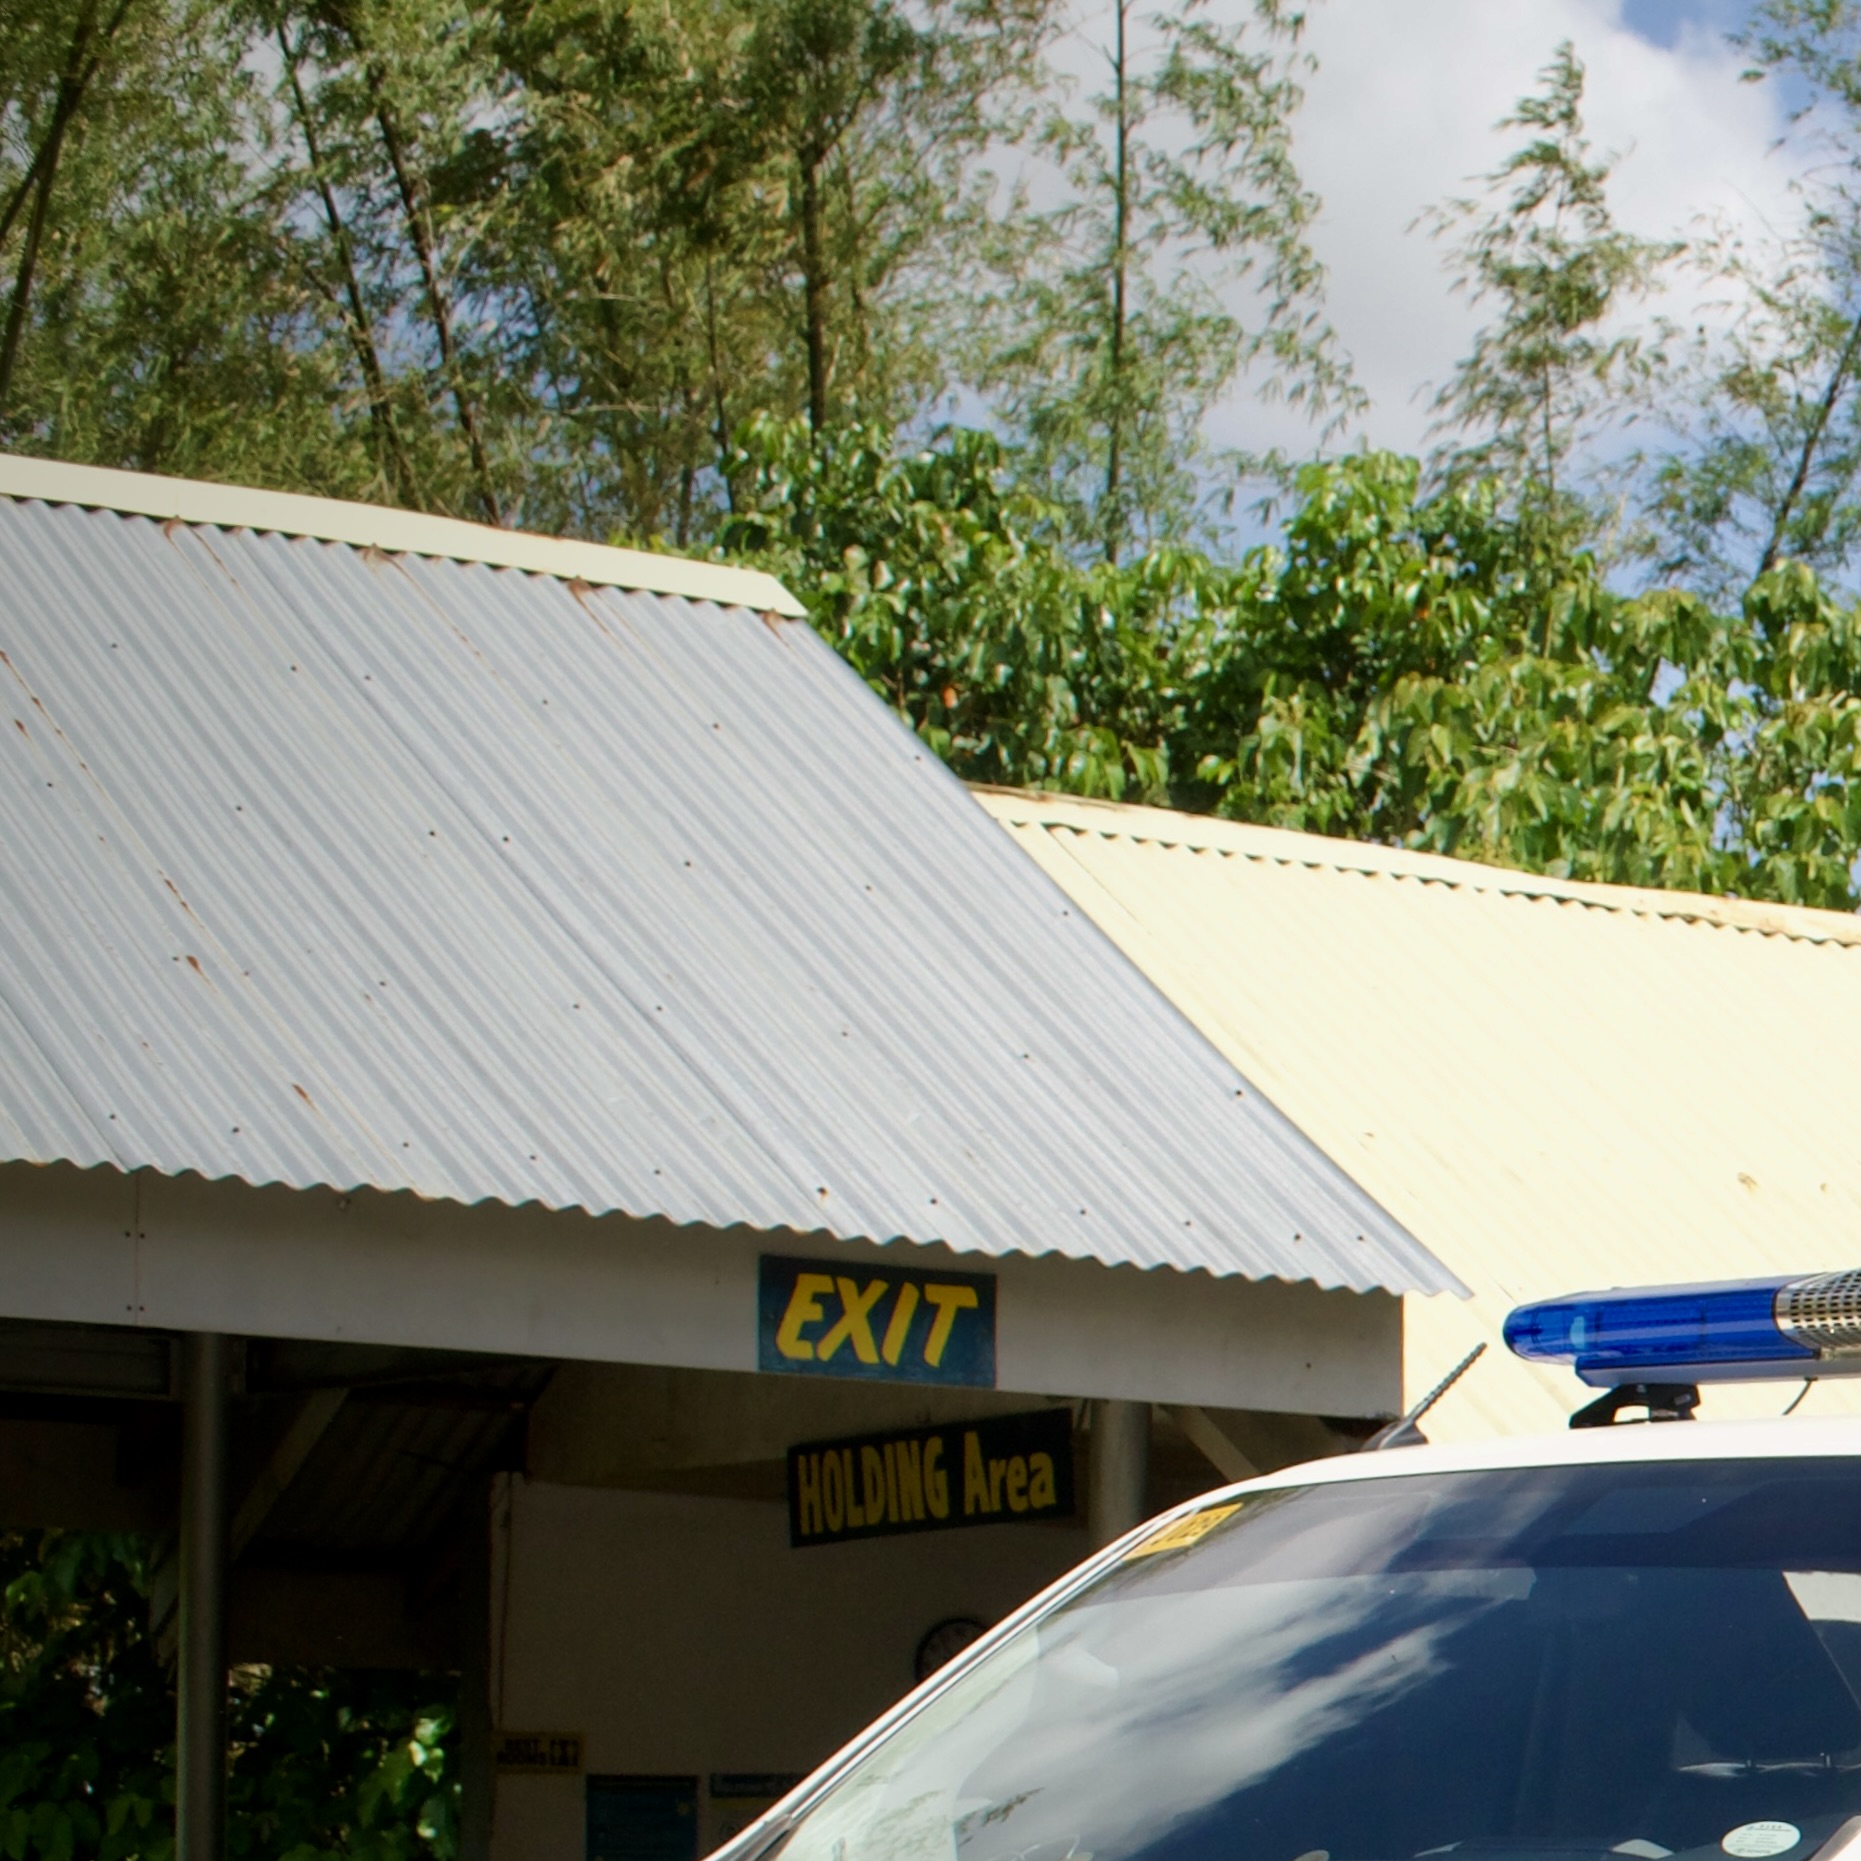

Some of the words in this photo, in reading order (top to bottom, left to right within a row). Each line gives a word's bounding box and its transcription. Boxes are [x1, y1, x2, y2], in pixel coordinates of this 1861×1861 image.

[775, 1272, 978, 1367] EXIT
[797, 1435, 949, 1536] HOLDING
[962, 1430, 1057, 1516] Area
